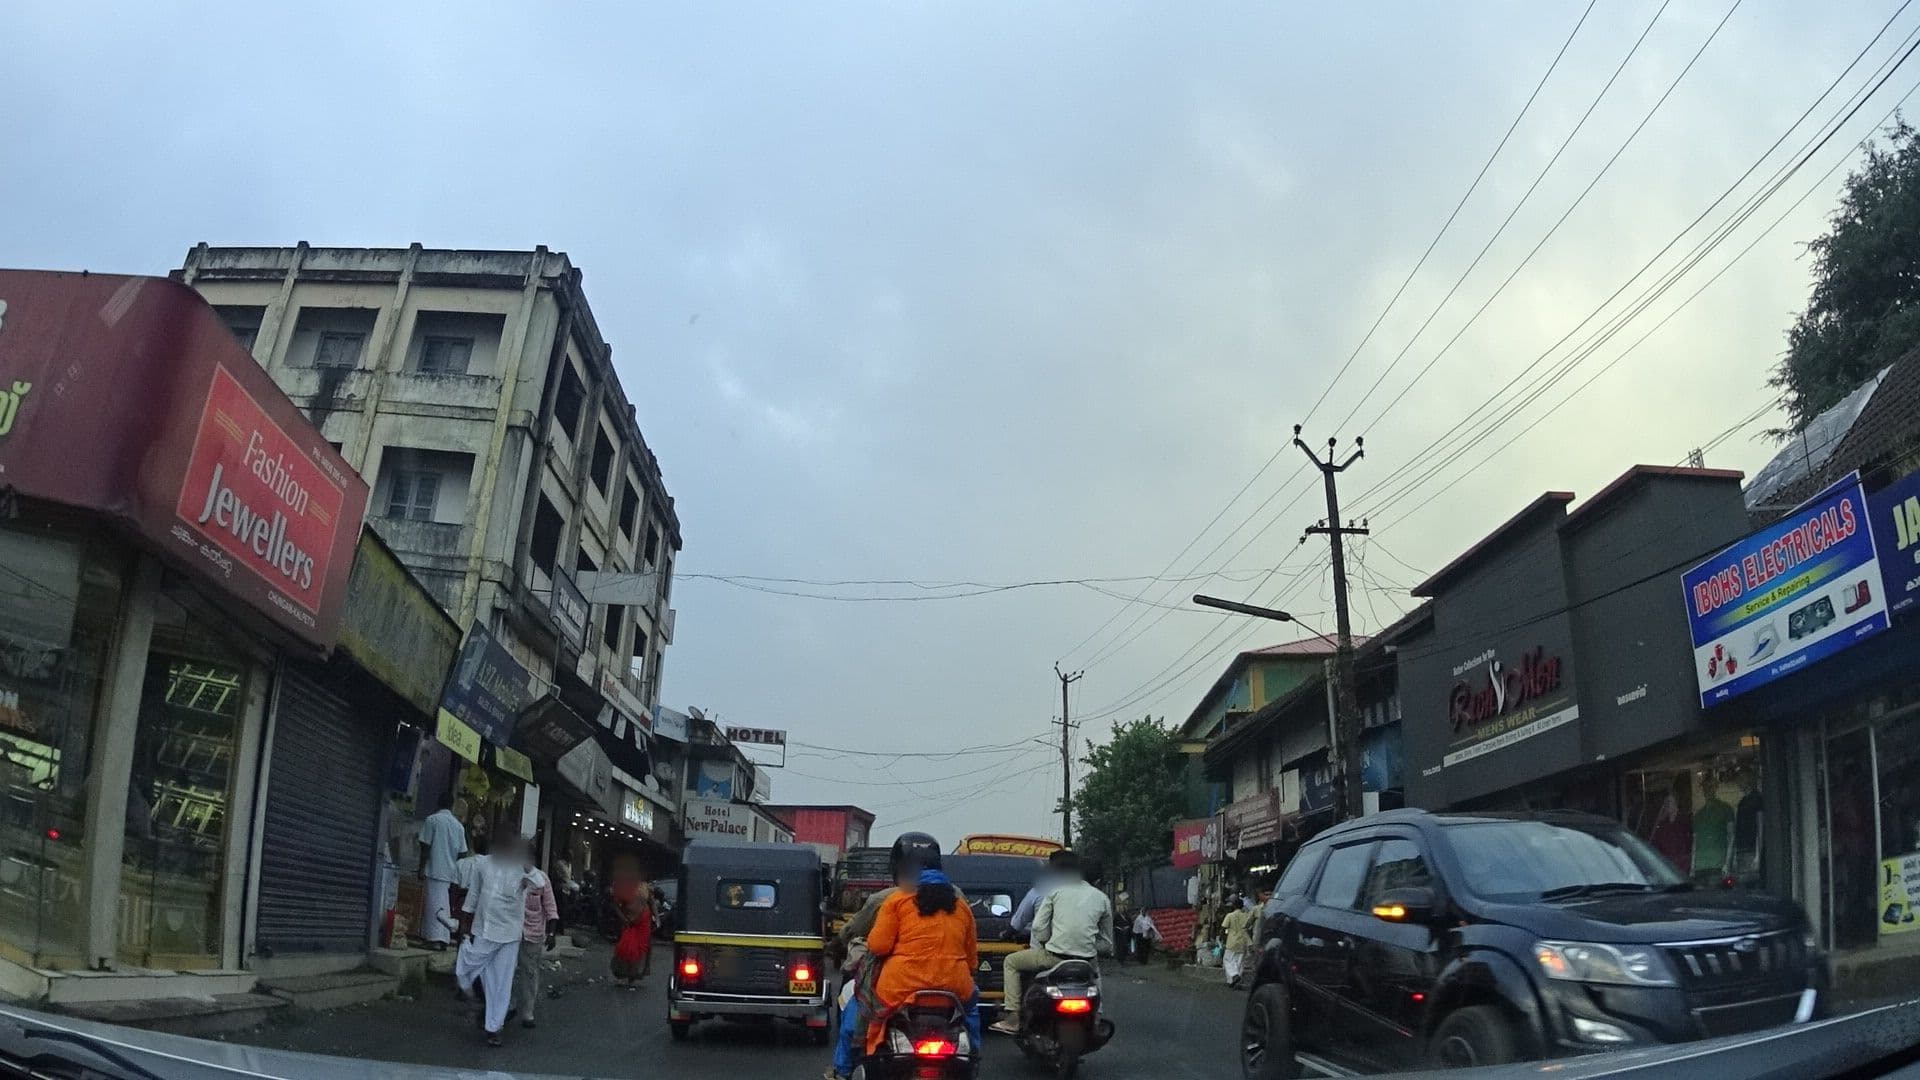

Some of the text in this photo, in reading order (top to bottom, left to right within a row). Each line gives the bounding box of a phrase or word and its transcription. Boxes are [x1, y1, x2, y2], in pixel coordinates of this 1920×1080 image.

[243, 429, 309, 517] Fashion
[198, 462, 314, 589] Jewellers
[1742, 498, 1856, 592] ELECTRICALS
[1745, 593, 1771, 614] Service
[1777, 575, 1810, 598] Repairing
[726, 727, 785, 744] HOTEL
[1477, 720, 1505, 741] MENS
[1506, 706, 1537, 730] WEAR
[704, 805, 731, 817] Hotel
